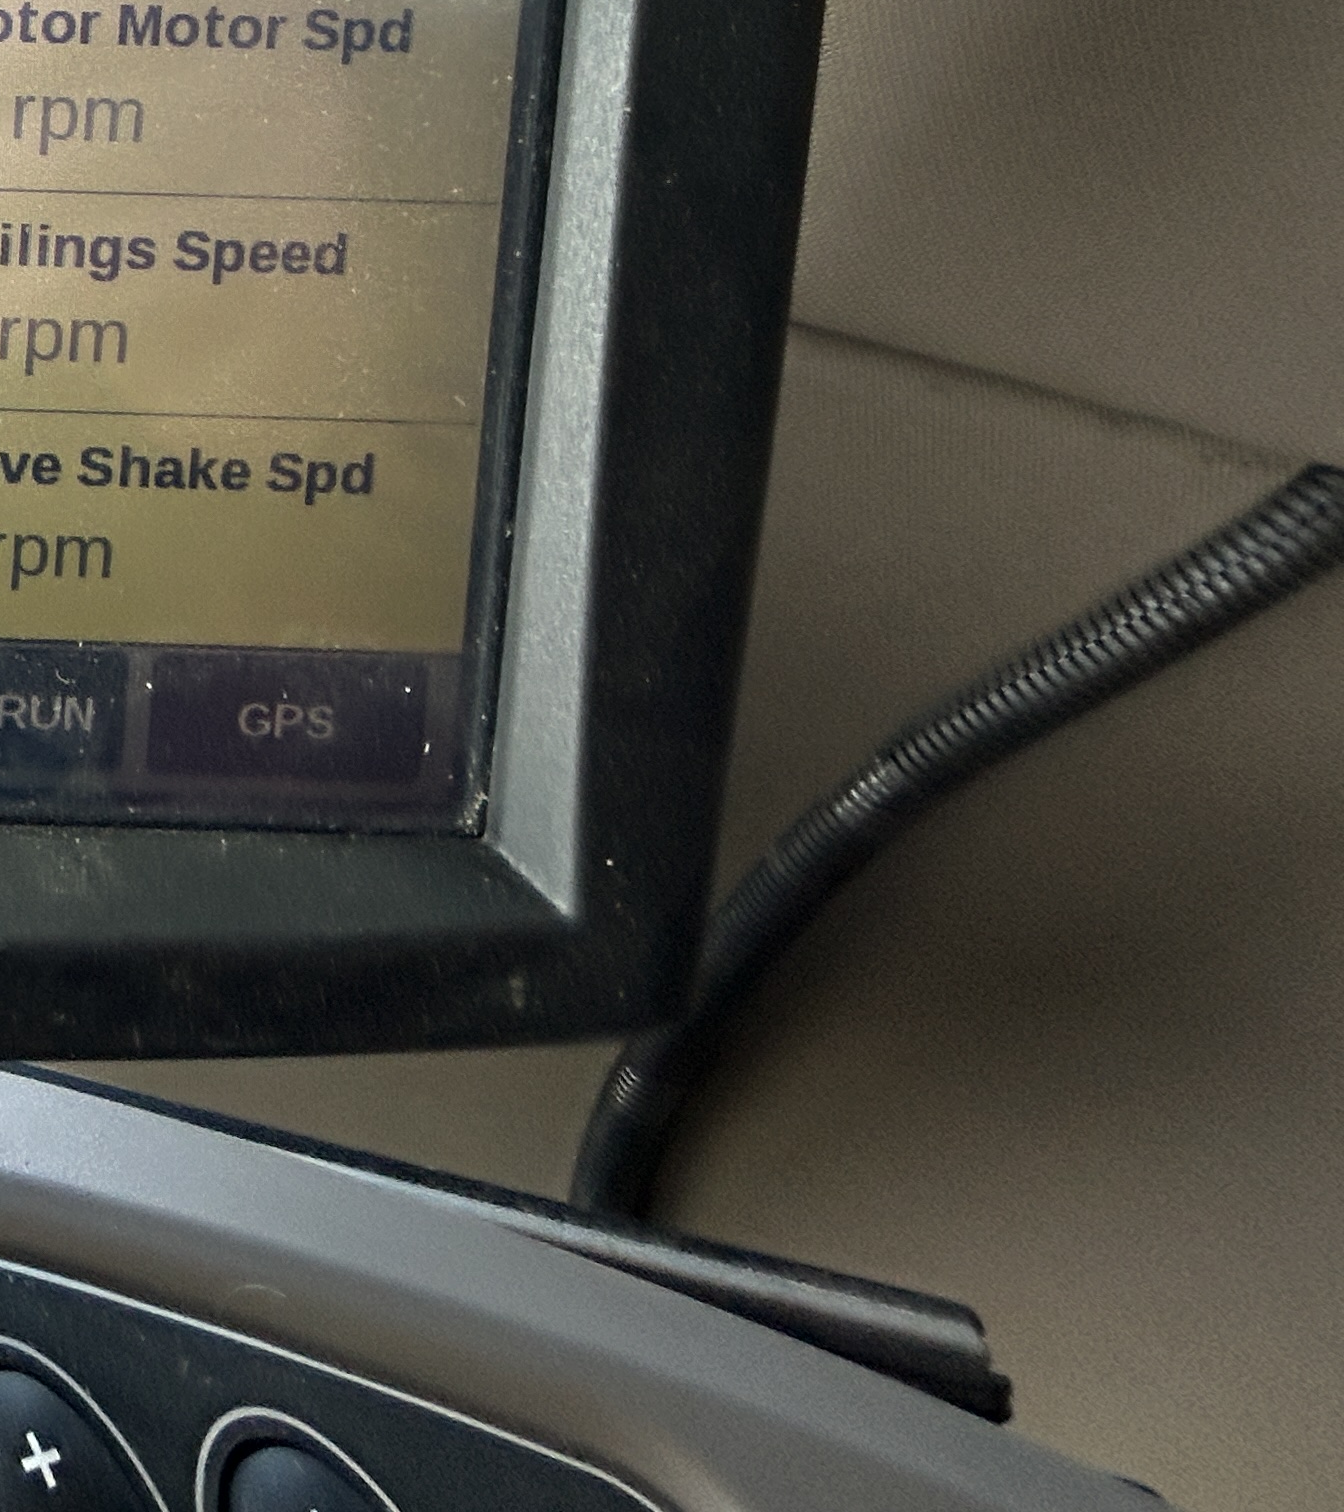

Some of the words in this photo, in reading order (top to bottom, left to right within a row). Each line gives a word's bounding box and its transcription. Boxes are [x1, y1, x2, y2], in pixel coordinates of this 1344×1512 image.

[117, 3, 286, 51] Motor
[301, 7, 415, 65] Spd
[13, 93, 144, 156] rpm
[172, 230, 349, 284] Speed
[77, 445, 251, 492] Shake
[265, 451, 377, 506] Spd
[238, 700, 336, 741] GPS
